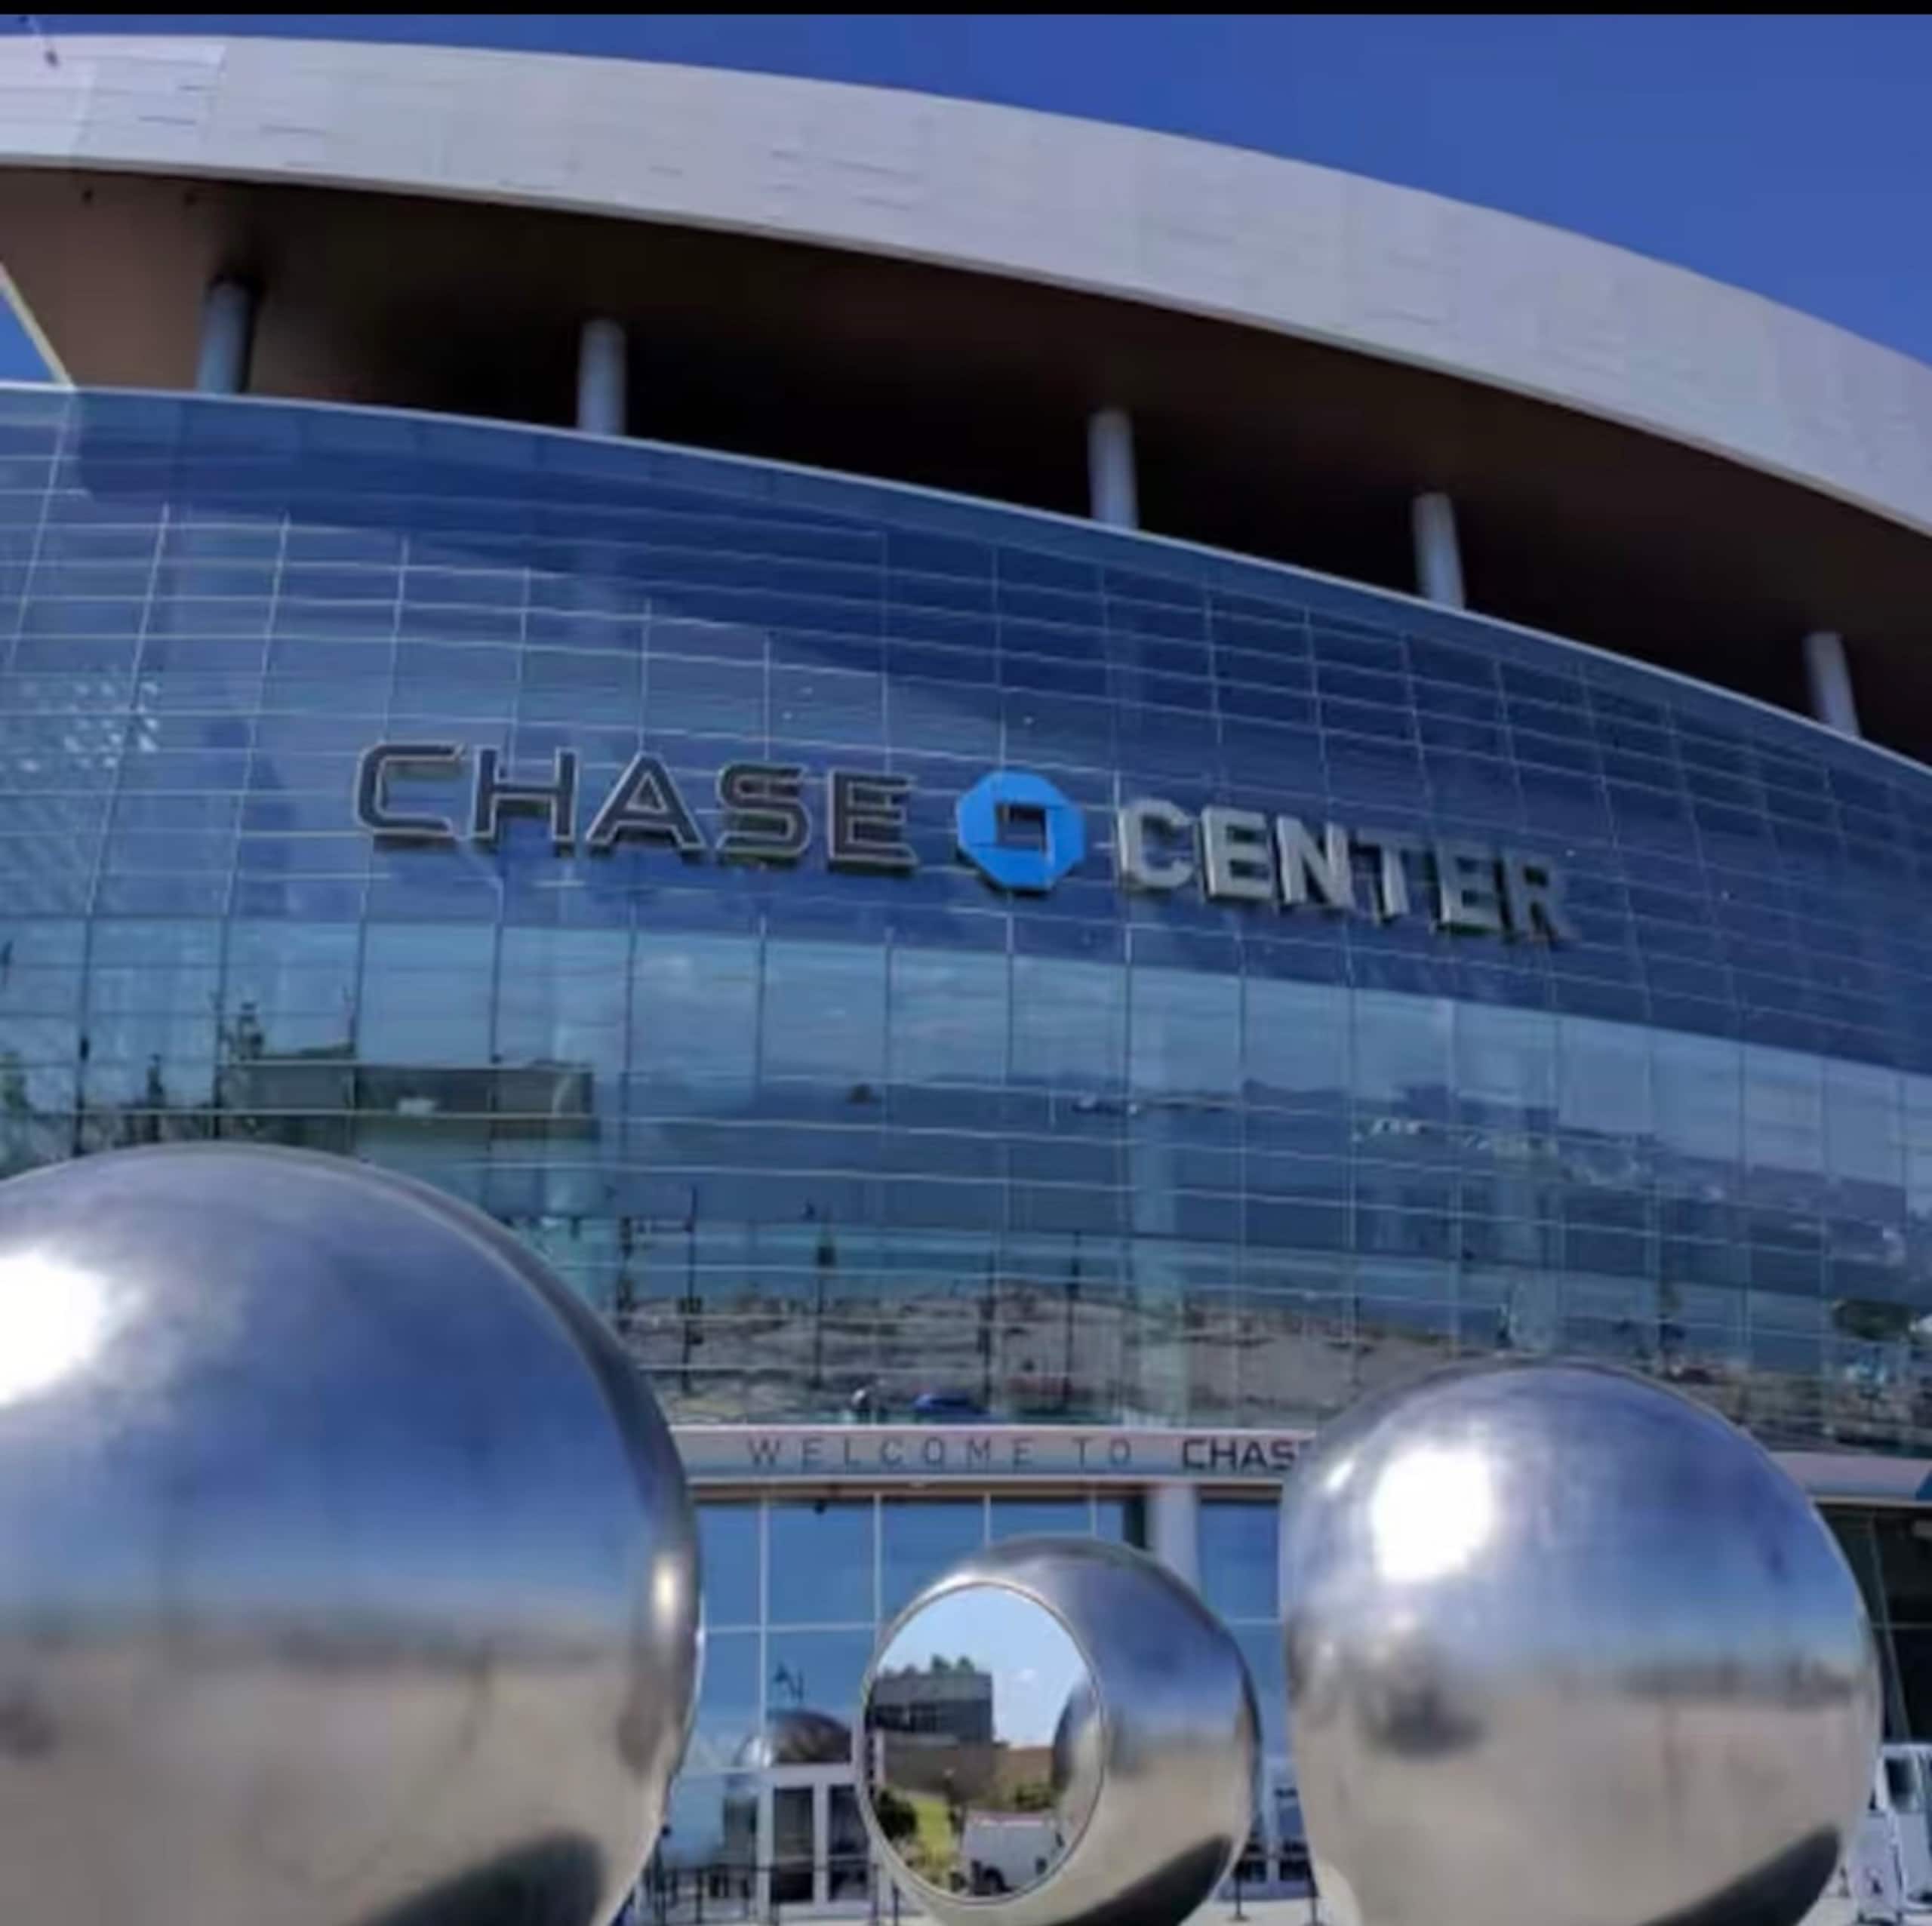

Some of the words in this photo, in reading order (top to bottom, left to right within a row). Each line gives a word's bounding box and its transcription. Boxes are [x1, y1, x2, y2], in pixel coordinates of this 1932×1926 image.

[353, 741, 919, 872] CHASE
[1117, 797, 1574, 942] CENTER
[747, 1435, 1035, 1468] WELCOME
[1071, 1435, 1132, 1468] TO
[1182, 1436, 1310, 1470] CHAS
